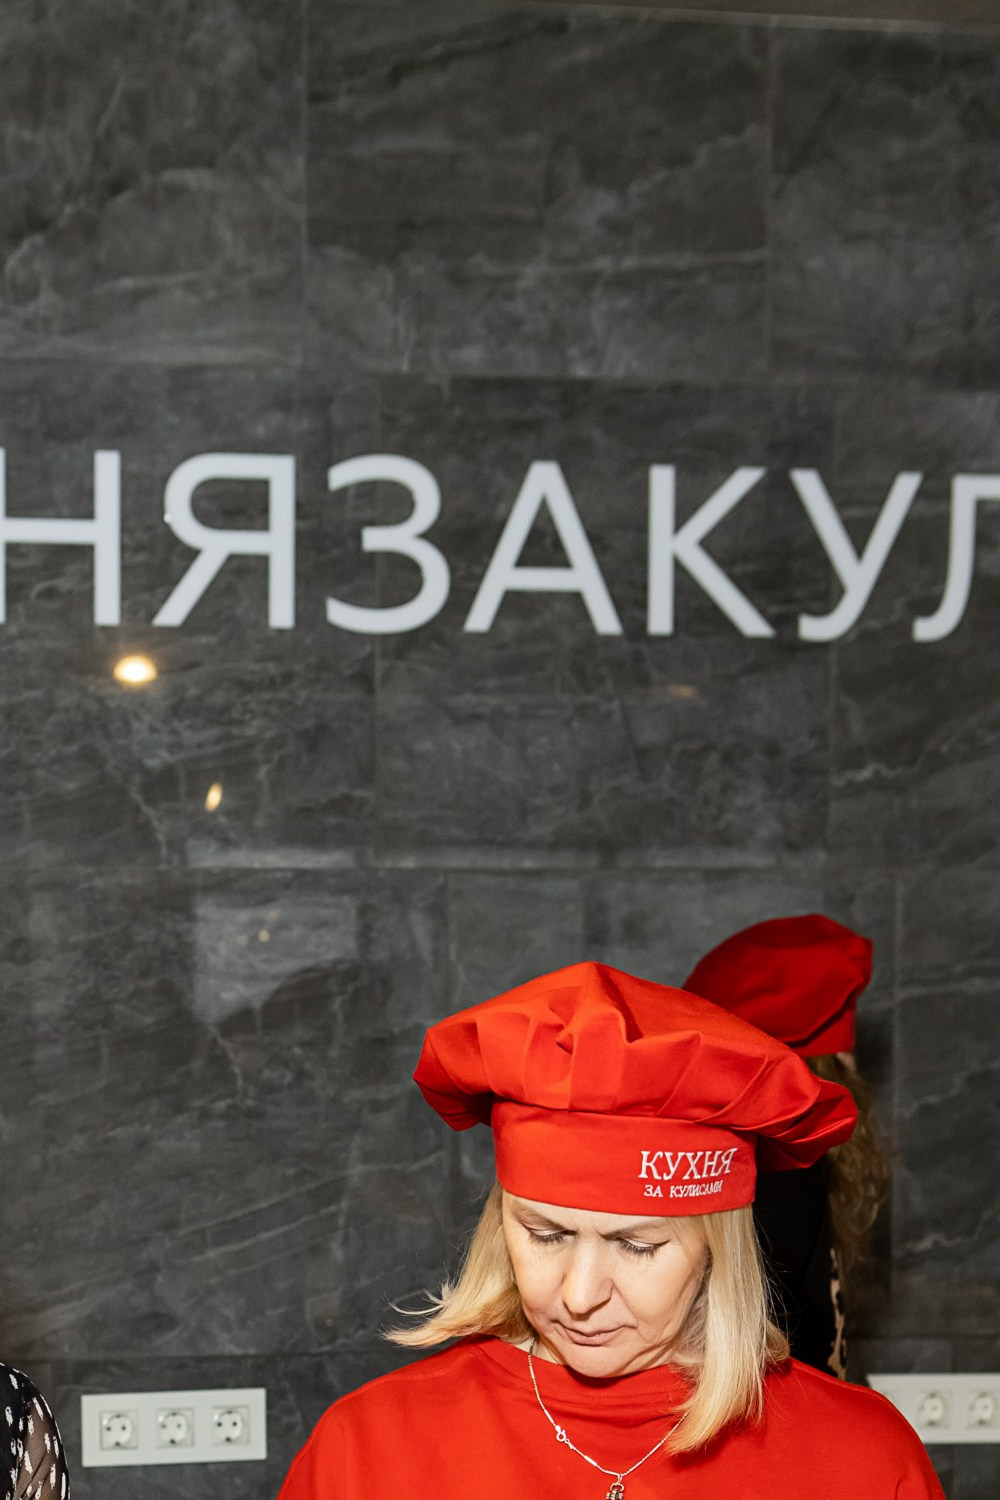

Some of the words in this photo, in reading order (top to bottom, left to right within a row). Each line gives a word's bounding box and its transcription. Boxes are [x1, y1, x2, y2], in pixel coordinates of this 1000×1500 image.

[638, 1148, 738, 1180] КУХНЯ
[643, 1184, 663, 1198] ЗА
[669, 1180, 723, 1198] КУЛИСАМИ
